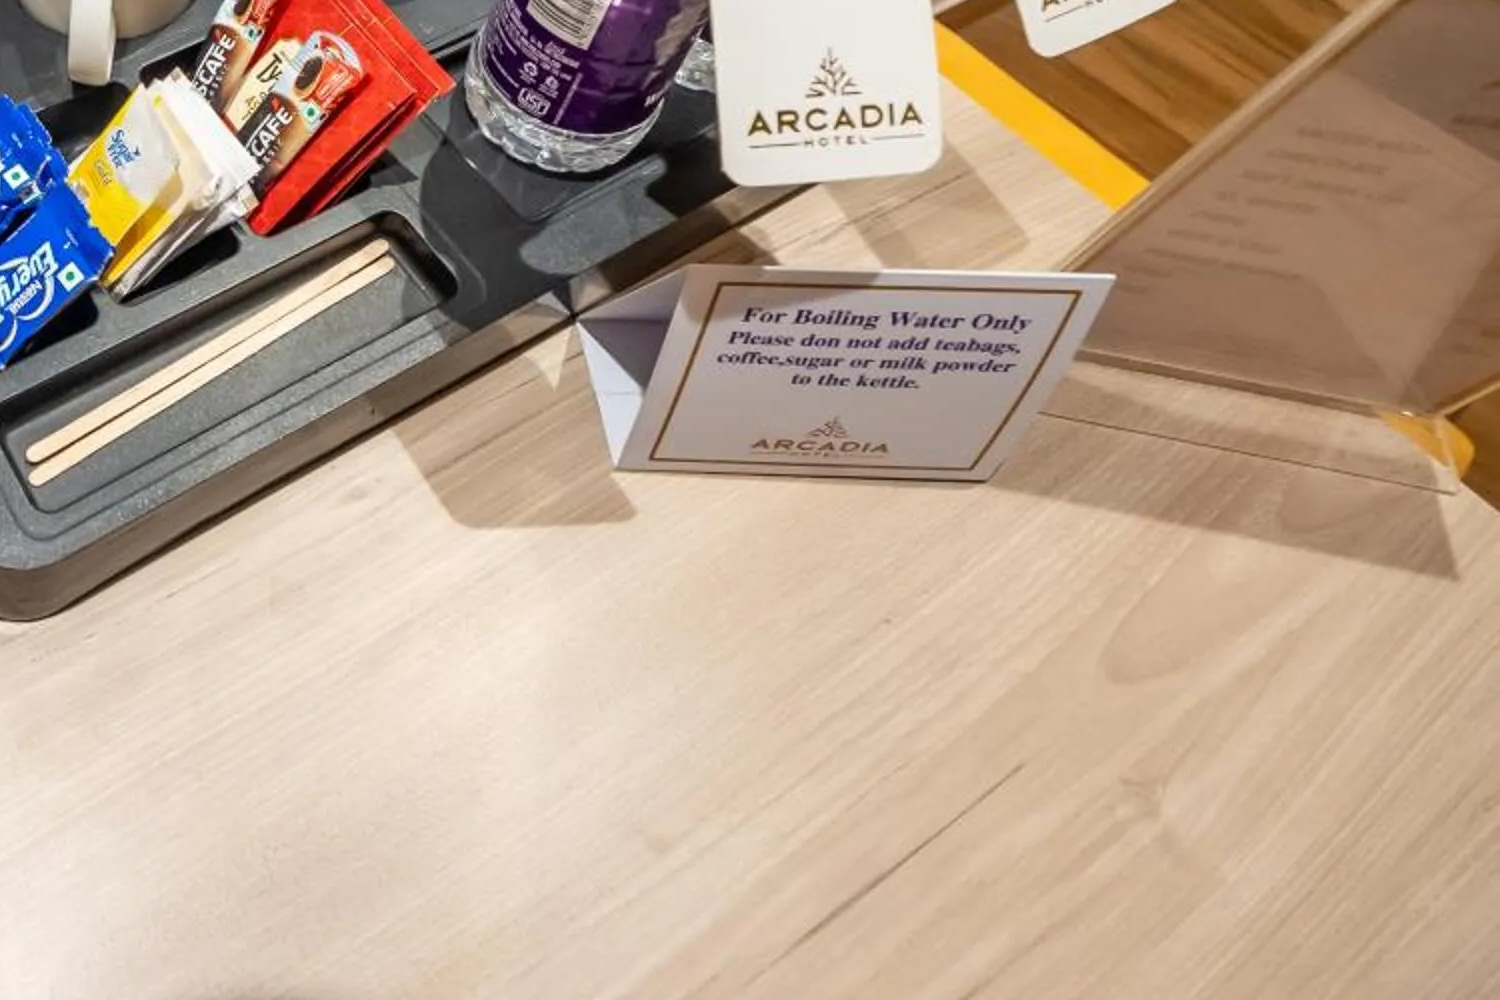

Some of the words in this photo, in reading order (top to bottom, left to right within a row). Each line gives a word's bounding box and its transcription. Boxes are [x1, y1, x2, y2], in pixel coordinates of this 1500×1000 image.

[747, 102, 923, 137] ARCADIA
[803, 136, 869, 148] HOTEL
[741, 306, 788, 325] For
[791, 308, 880, 330] Boiling
[889, 311, 965, 329] Water
[971, 312, 1033, 335] Only
[728, 330, 795, 347] Please
[801, 333, 840, 349] don
[845, 336, 884, 350] not
[887, 335, 930, 351] add
[935, 337, 1022, 356] teabags,
[850, 357, 875, 369] or
[879, 355, 927, 371] milk
[932, 358, 1017, 374] powder
[790, 374, 811, 386] to
[817, 373, 851, 387] the
[855, 374, 921, 390] kettle.
[750, 438, 889, 454] ARCADIA
